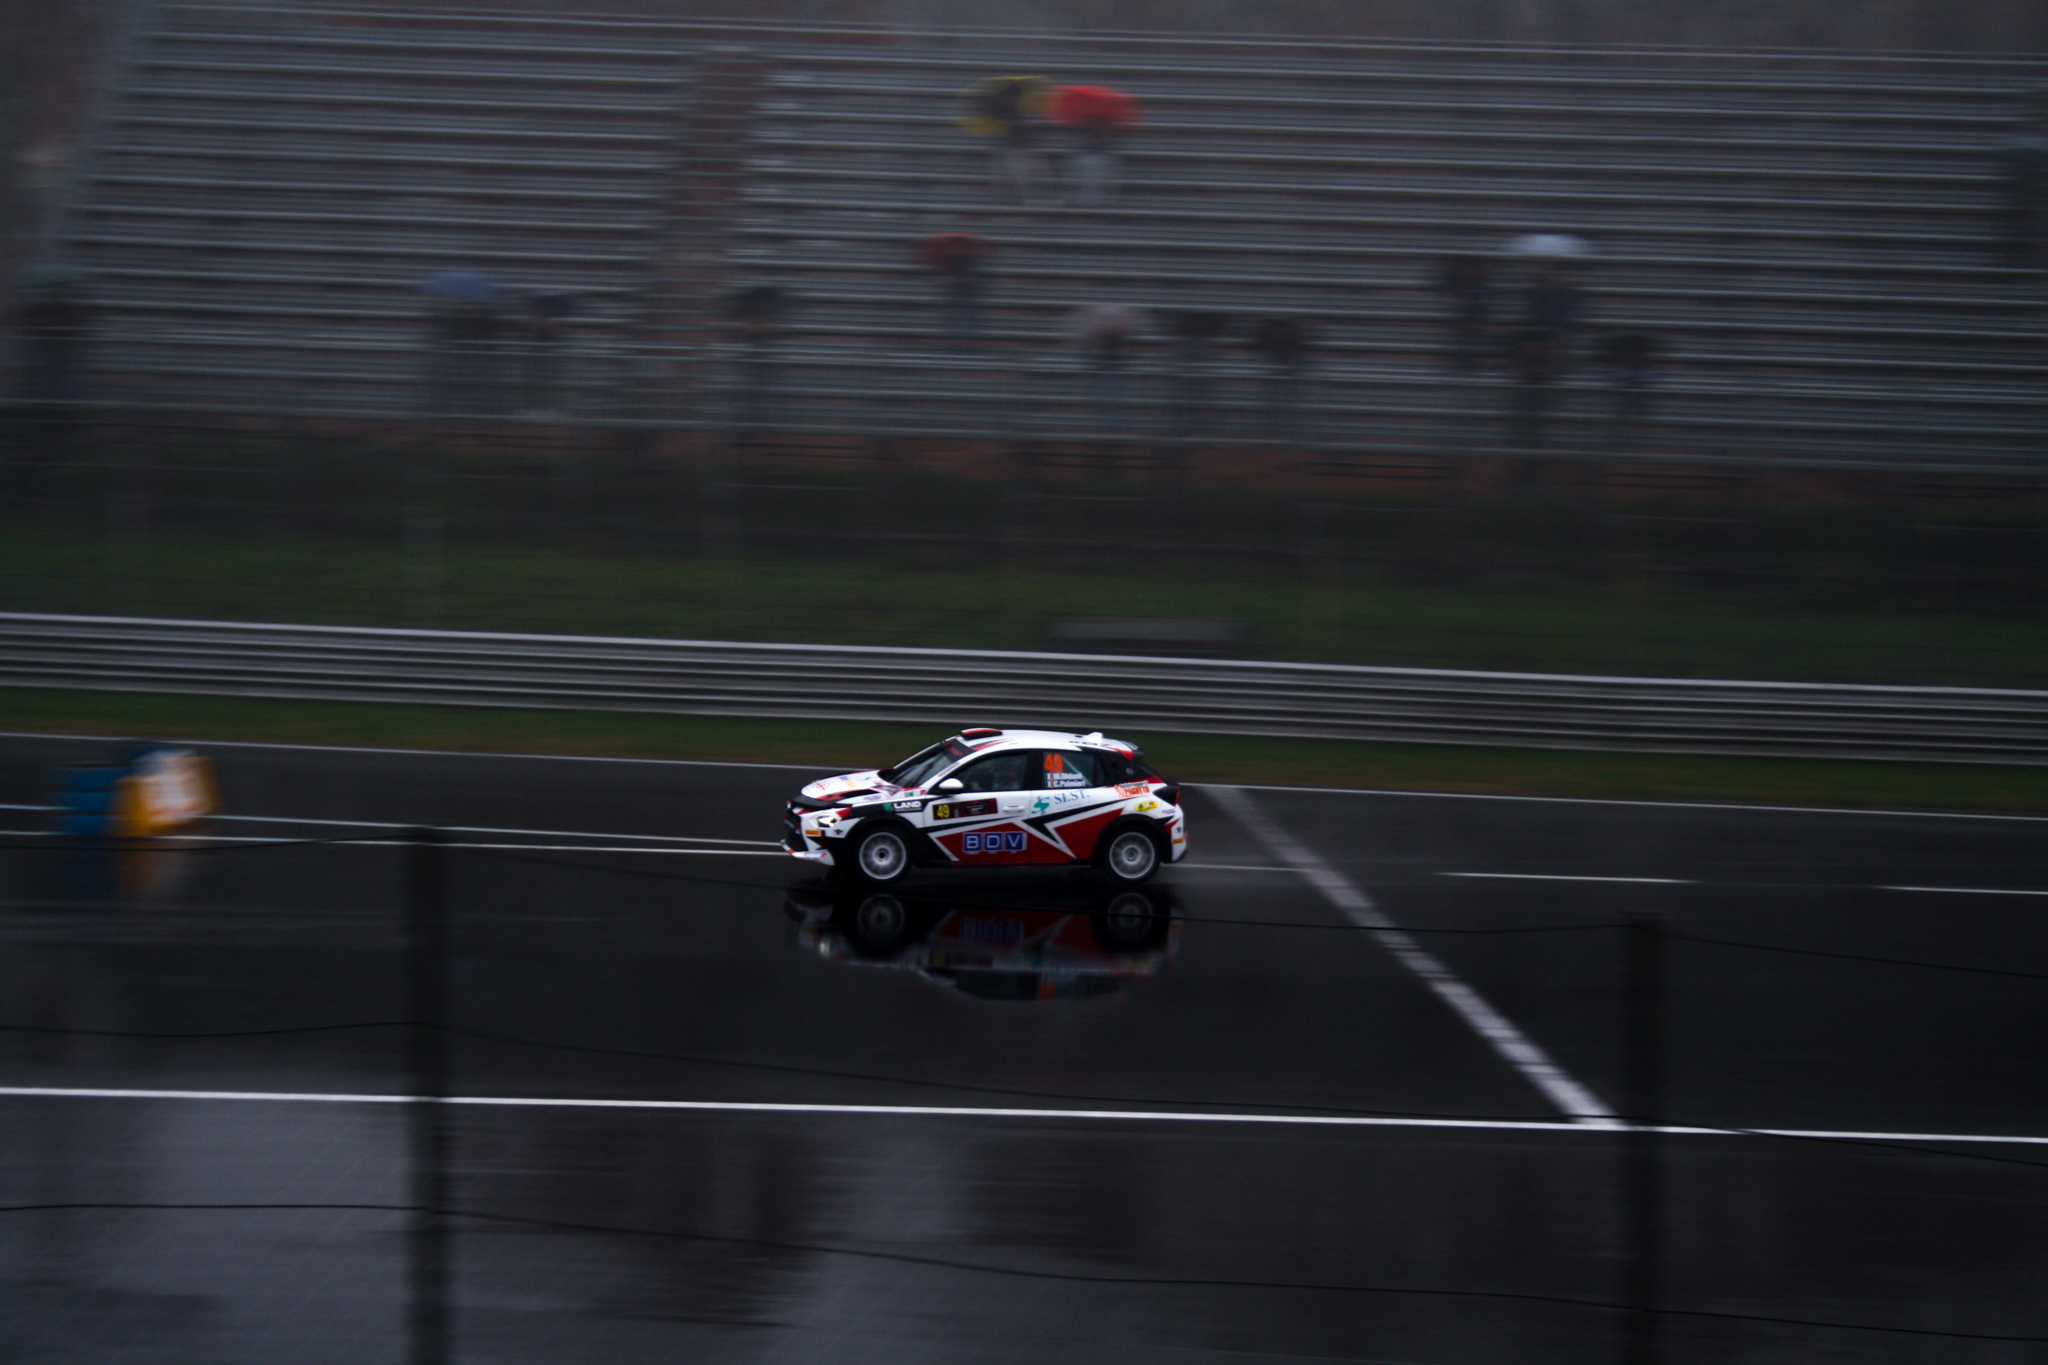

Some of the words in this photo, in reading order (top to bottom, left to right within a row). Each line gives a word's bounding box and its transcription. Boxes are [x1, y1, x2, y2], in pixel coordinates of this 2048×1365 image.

[1044, 753, 1063, 773] 49
[894, 801, 921, 809] LAND
[936, 804, 951, 819] 49
[966, 834, 1021, 849] BDV
